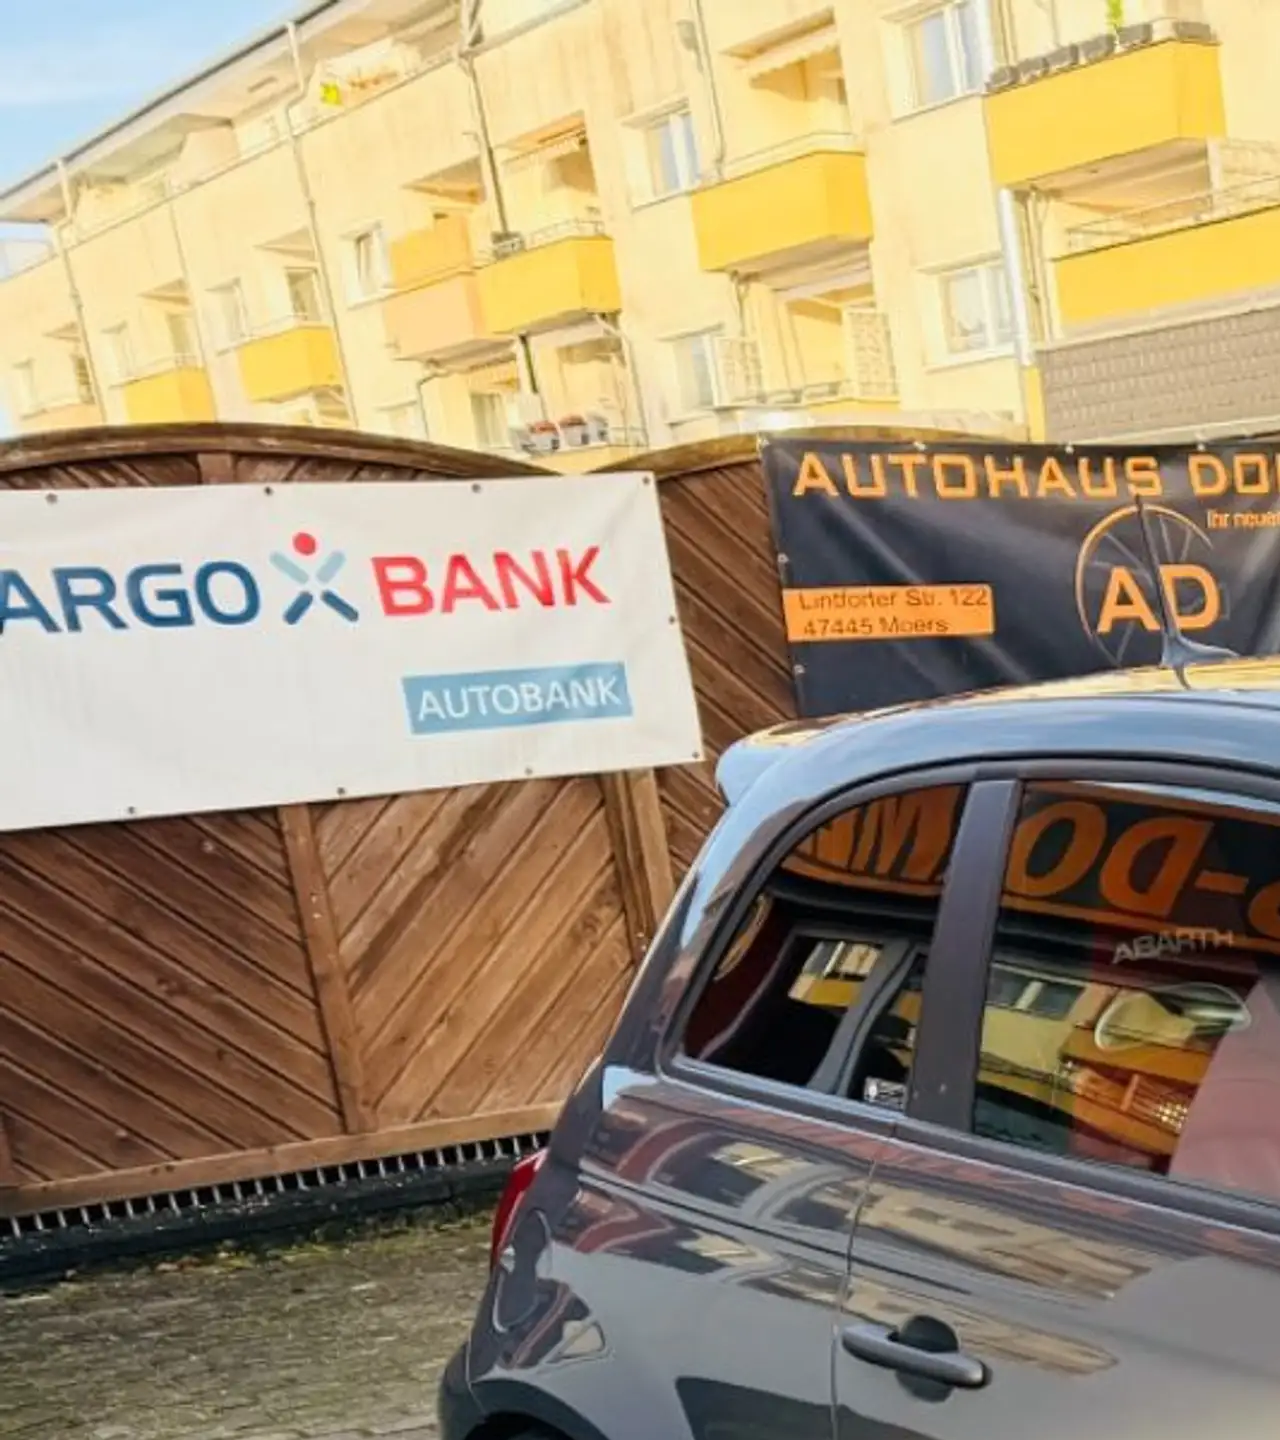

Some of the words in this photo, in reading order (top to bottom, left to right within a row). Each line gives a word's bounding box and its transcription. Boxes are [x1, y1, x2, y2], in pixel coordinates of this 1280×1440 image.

[793, 452, 1163, 498] AUTOHAUS
[370, 545, 613, 617] BANK
[950, 587, 989, 607] 122
[1096, 563, 1220, 634] AD
[804, 617, 874, 636] 47445
[879, 616, 950, 635] Moers
[417, 675, 622, 723] AUTOBANK
[1111, 927, 1236, 965] ABARTH
